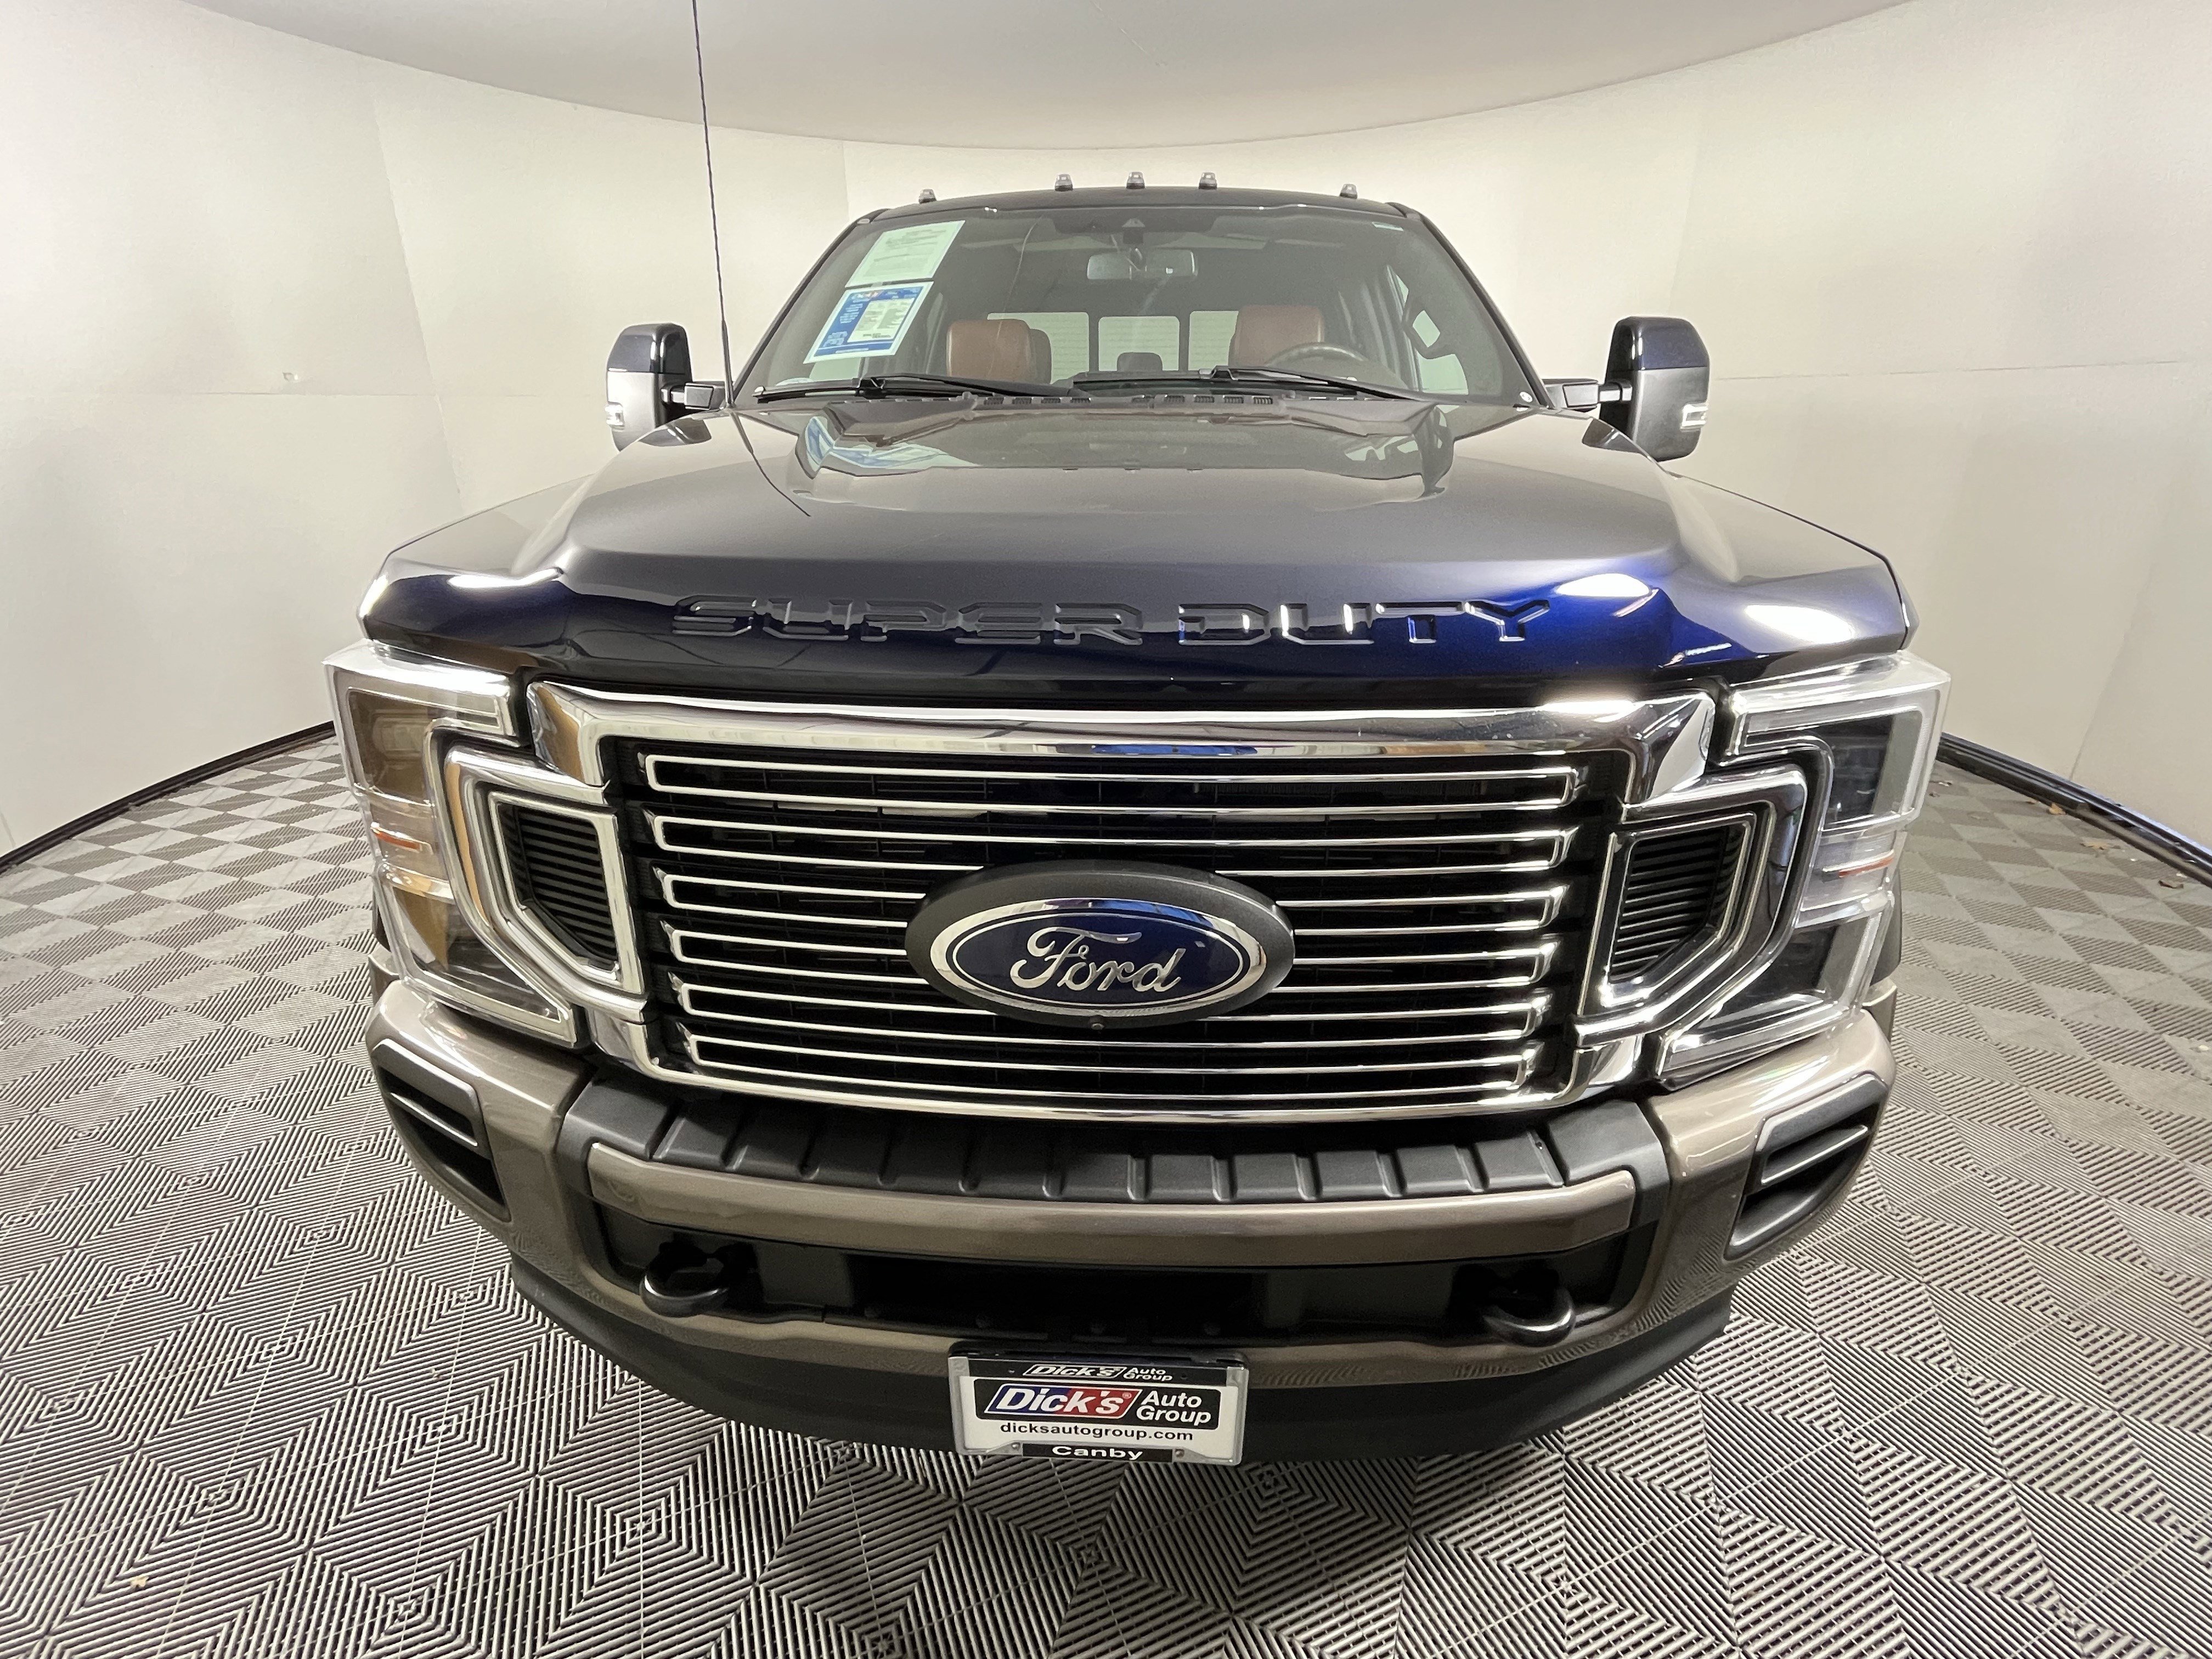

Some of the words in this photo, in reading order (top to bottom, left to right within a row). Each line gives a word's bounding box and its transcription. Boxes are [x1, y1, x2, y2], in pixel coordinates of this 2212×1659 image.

[672, 595, 1143, 645] SUPER
[1178, 599, 1550, 645] DUTY
[1010, 926, 1186, 992] Ford
[1123, 1373, 1173, 1381] Group
[1128, 1367, 1166, 1375] Auto
[1141, 1390, 1203, 1408] Auto
[1136, 1405, 1212, 1426] Group
[1000, 1423, 1193, 1441] dicksautogroup.com
[1052, 1446, 1143, 1460] Canby
